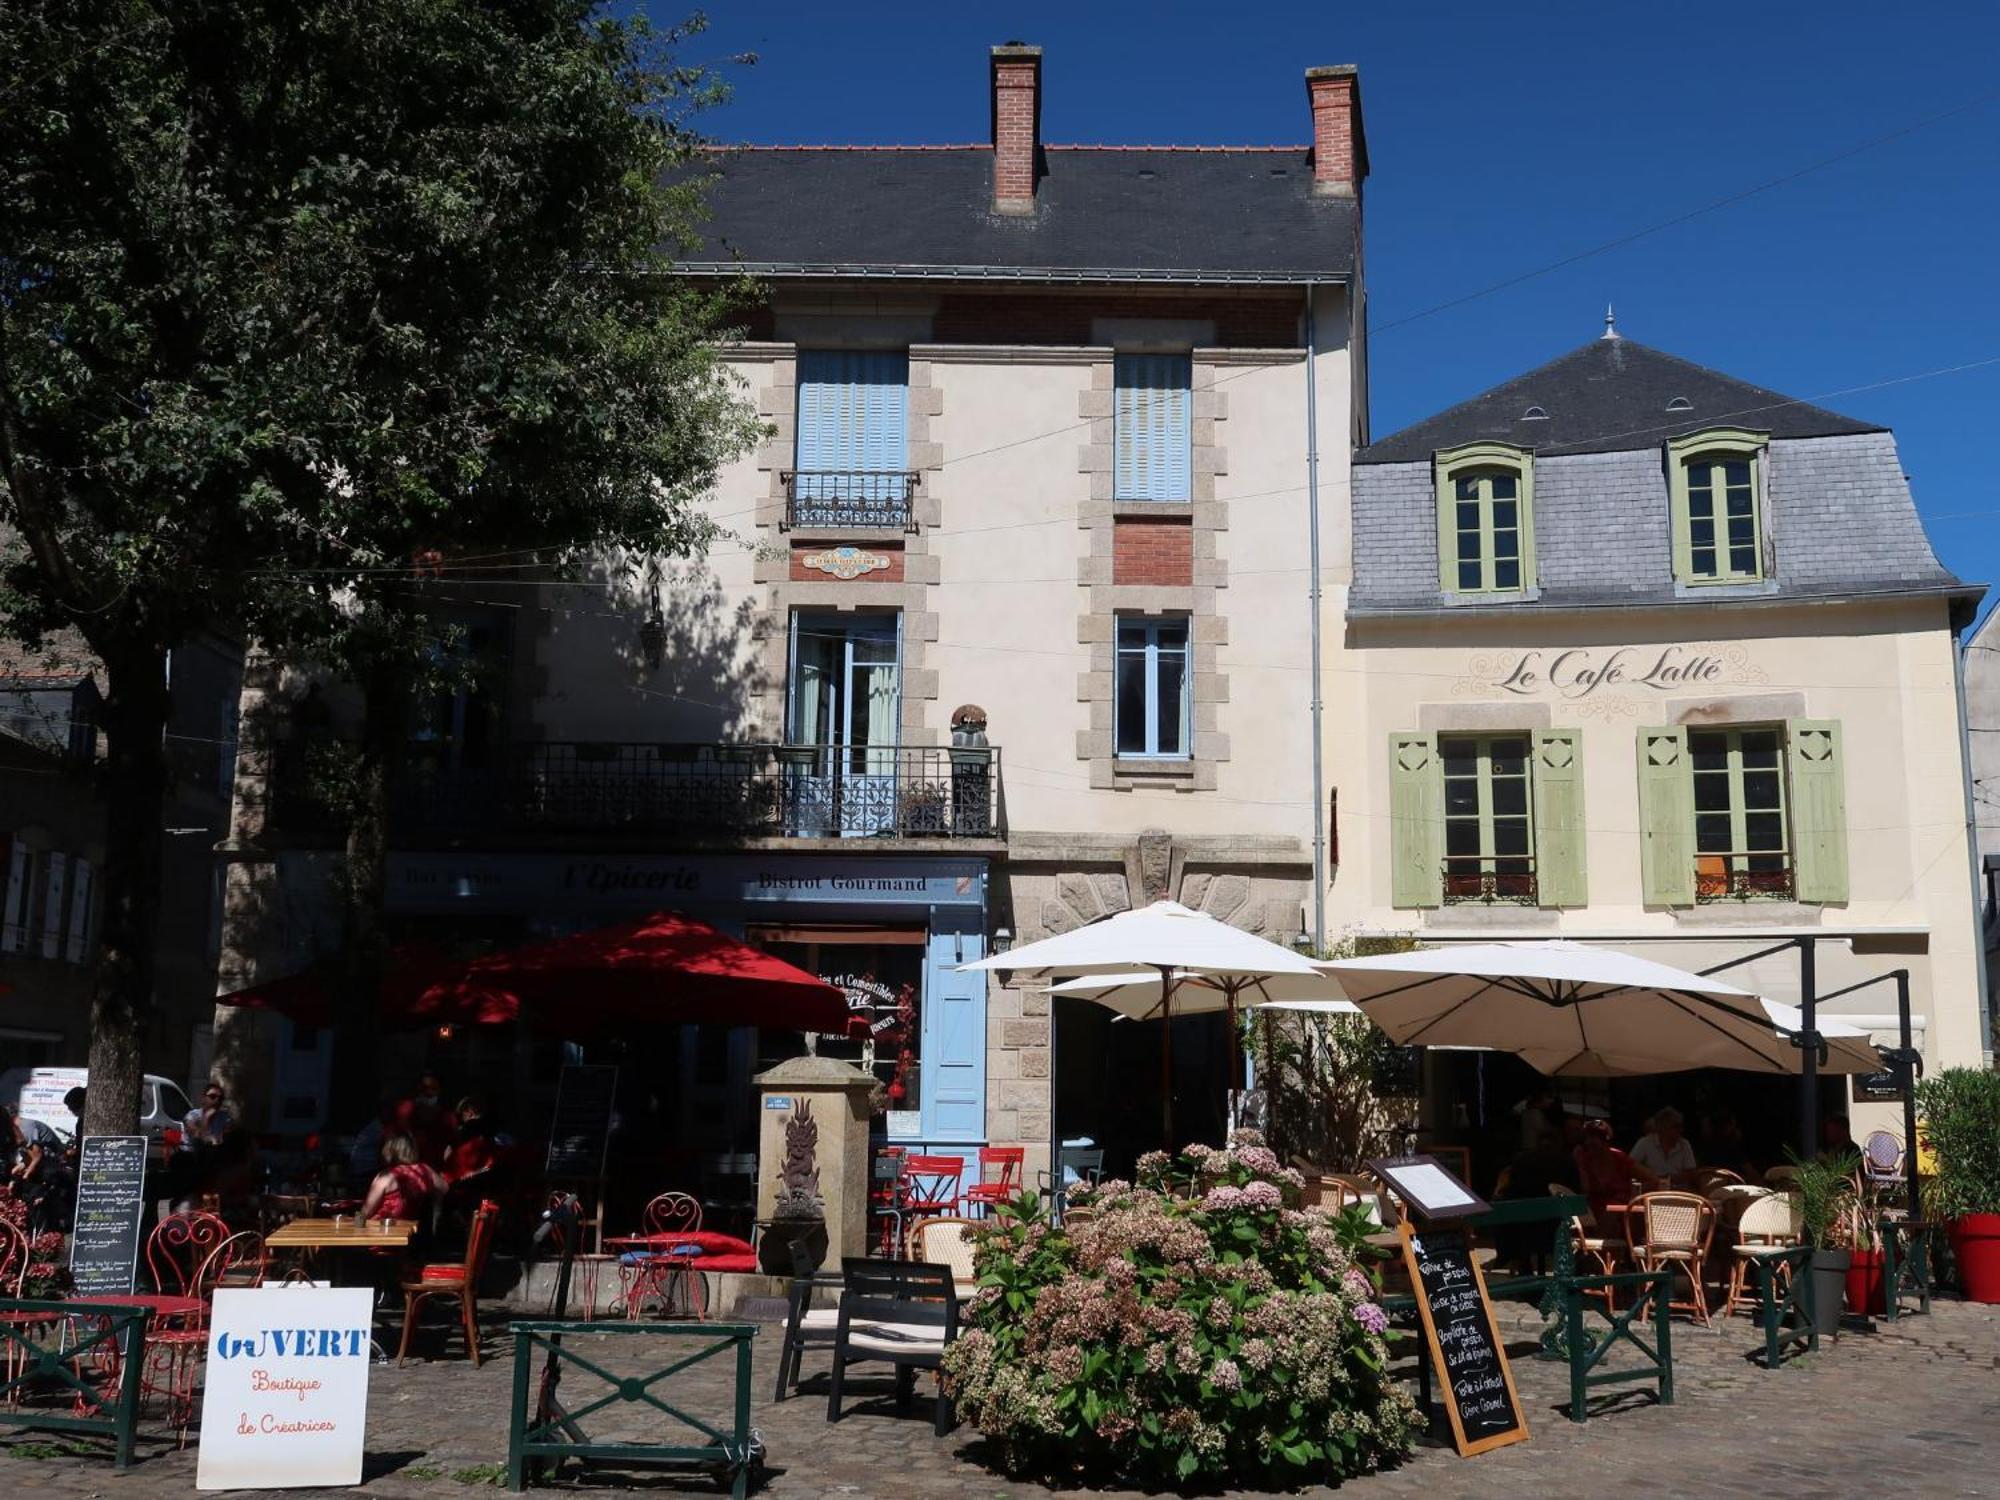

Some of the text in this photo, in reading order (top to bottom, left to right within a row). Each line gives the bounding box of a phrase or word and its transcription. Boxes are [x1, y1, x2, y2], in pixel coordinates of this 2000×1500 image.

[1491, 650, 1541, 694] Le
[1549, 648, 1640, 699] Café
[759, 873, 928, 891] Bistrot Gourmand
[217, 1329, 367, 1359] OUVERT
[252, 1370, 322, 1401] Boutique
[237, 1412, 257, 1434] de
